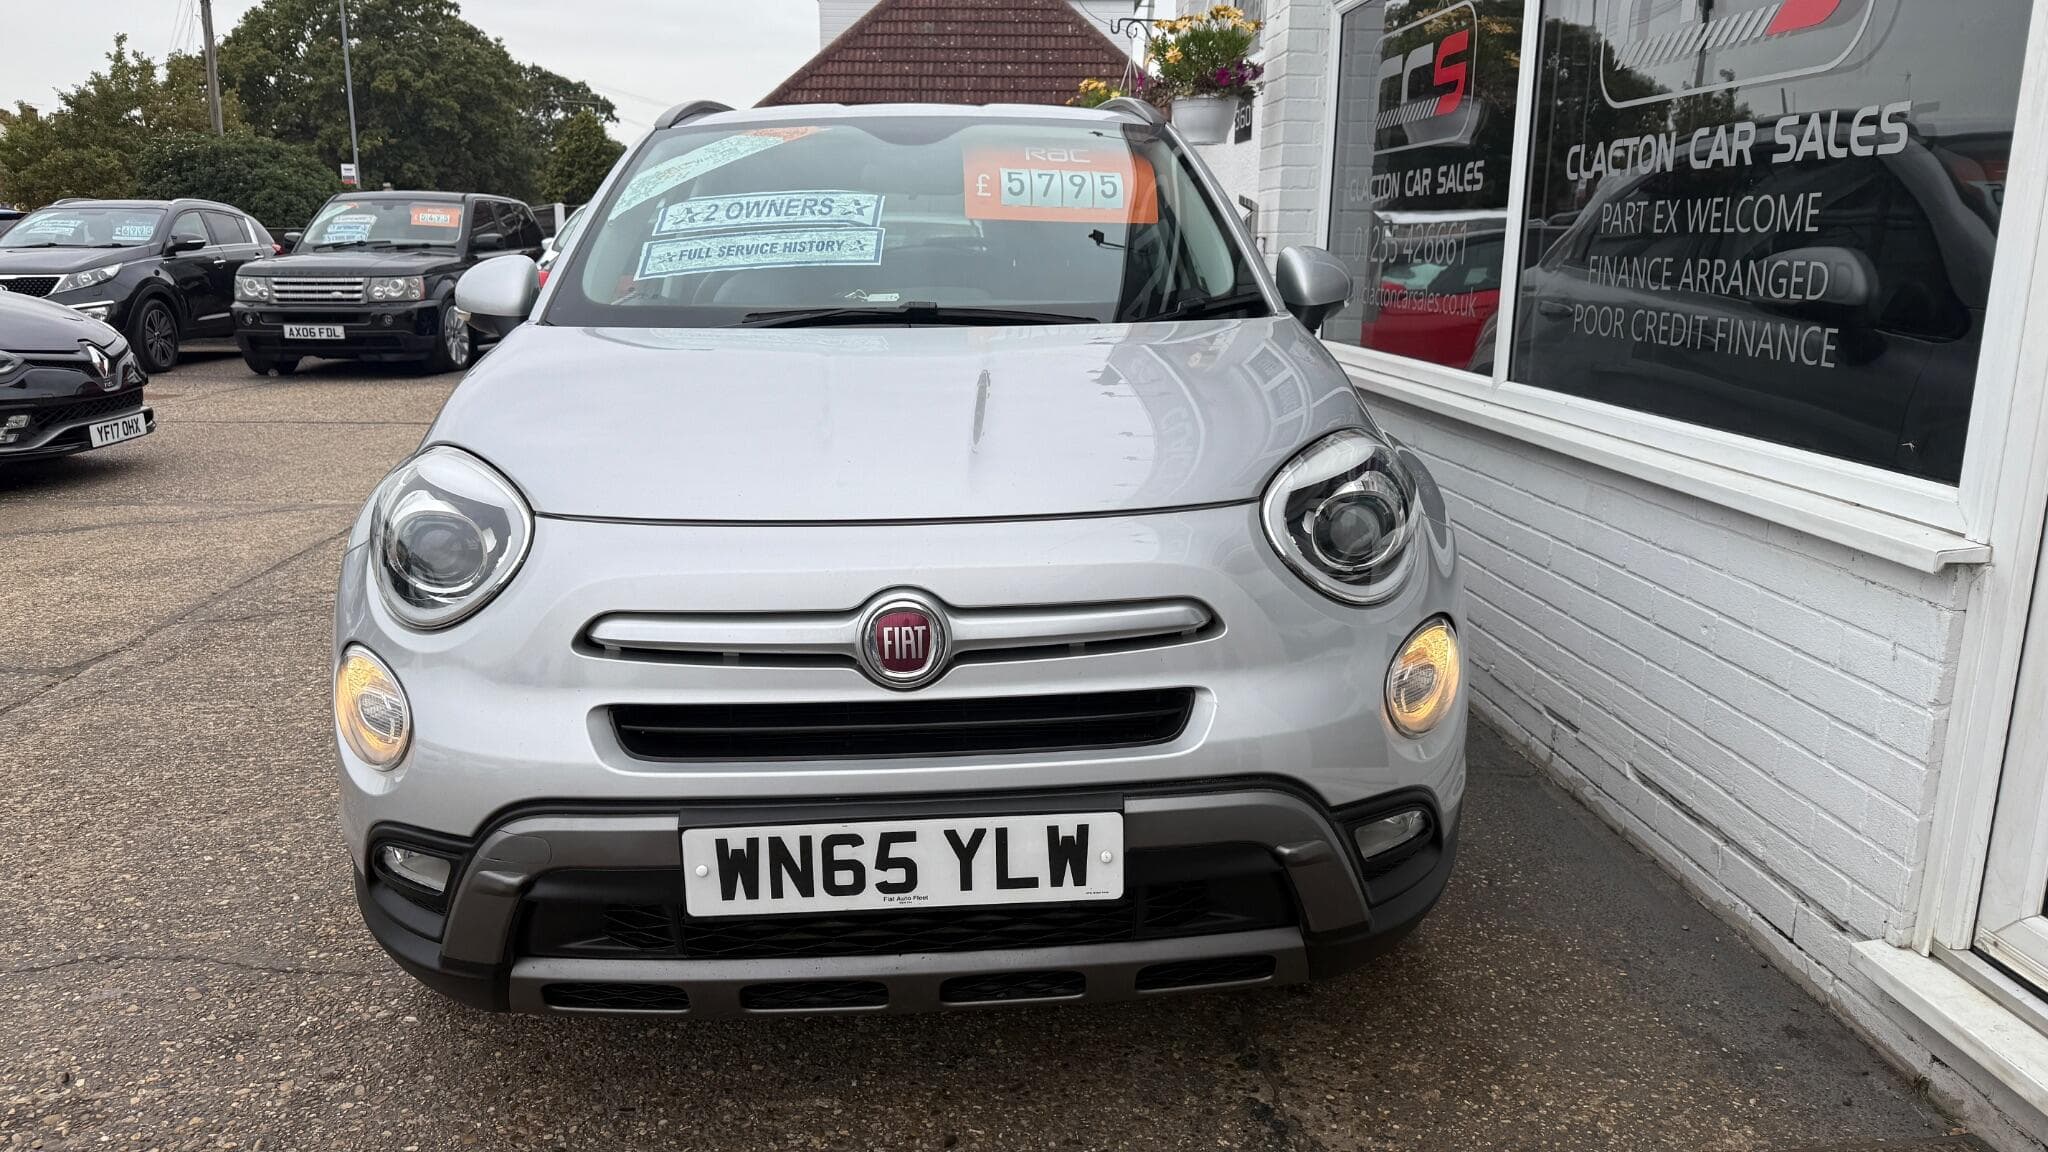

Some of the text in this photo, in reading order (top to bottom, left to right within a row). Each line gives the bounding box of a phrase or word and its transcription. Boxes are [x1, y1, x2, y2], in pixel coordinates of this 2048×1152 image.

[1689, 122, 1756, 170] CAR
[1772, 101, 1912, 164] SALES
[1405, 168, 1431, 197] CAR
[1437, 160, 1485, 195] SALES
[703, 198, 835, 223] 2 OWNERS
[1601, 192, 1822, 234] PART EX WELCOME
[678, 240, 846, 262] FULL SERVICE HISTORY
[1402, 222, 1467, 265] 426661
[1588, 255, 1829, 301] FINANCE ARRANGED
[288, 327, 341, 338] AX06 FDL
[1573, 304, 1839, 368] POOR CREDIT FINANCE
[97, 417, 141, 442] YF17 OHX
[883, 625, 927, 660] FIAT
[715, 823, 1090, 901] WN65 YLW
